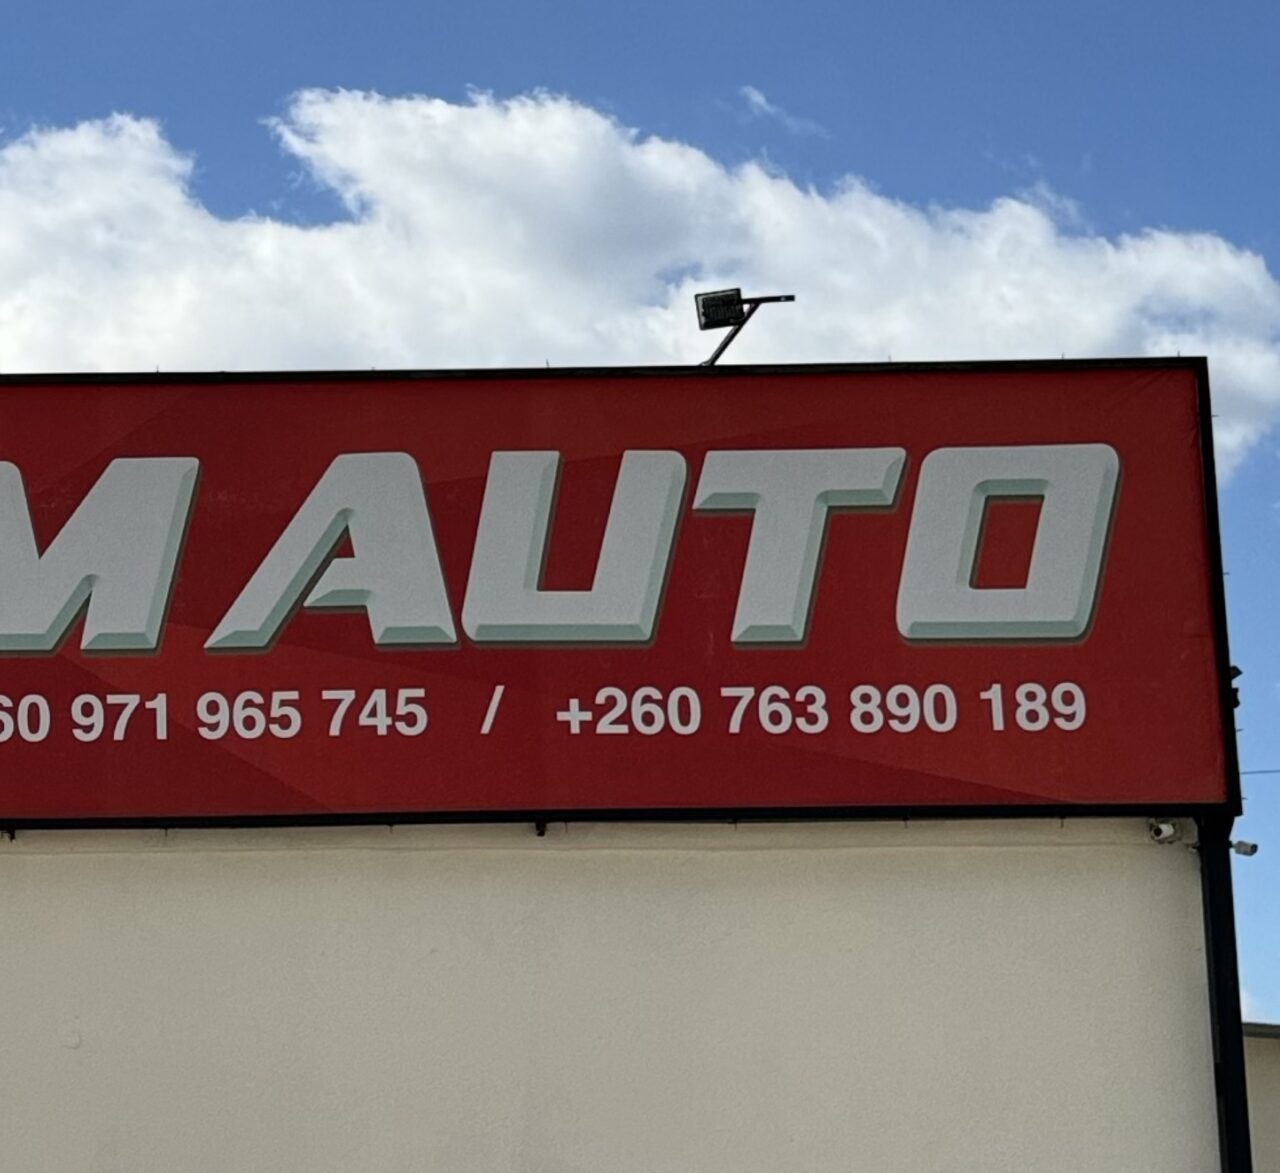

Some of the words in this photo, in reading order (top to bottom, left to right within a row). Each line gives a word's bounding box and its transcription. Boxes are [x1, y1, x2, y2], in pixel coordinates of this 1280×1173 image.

[202, 442, 1121, 650] AUTO
[70, 692, 168, 743] 971
[196, 690, 302, 740] 965
[321, 687, 428, 737] 745
[480, 684, 505, 735] /
[556, 686, 702, 736] +260
[720, 685, 829, 735] 763
[849, 683, 958, 734] 890
[979, 682, 1087, 732] 189
